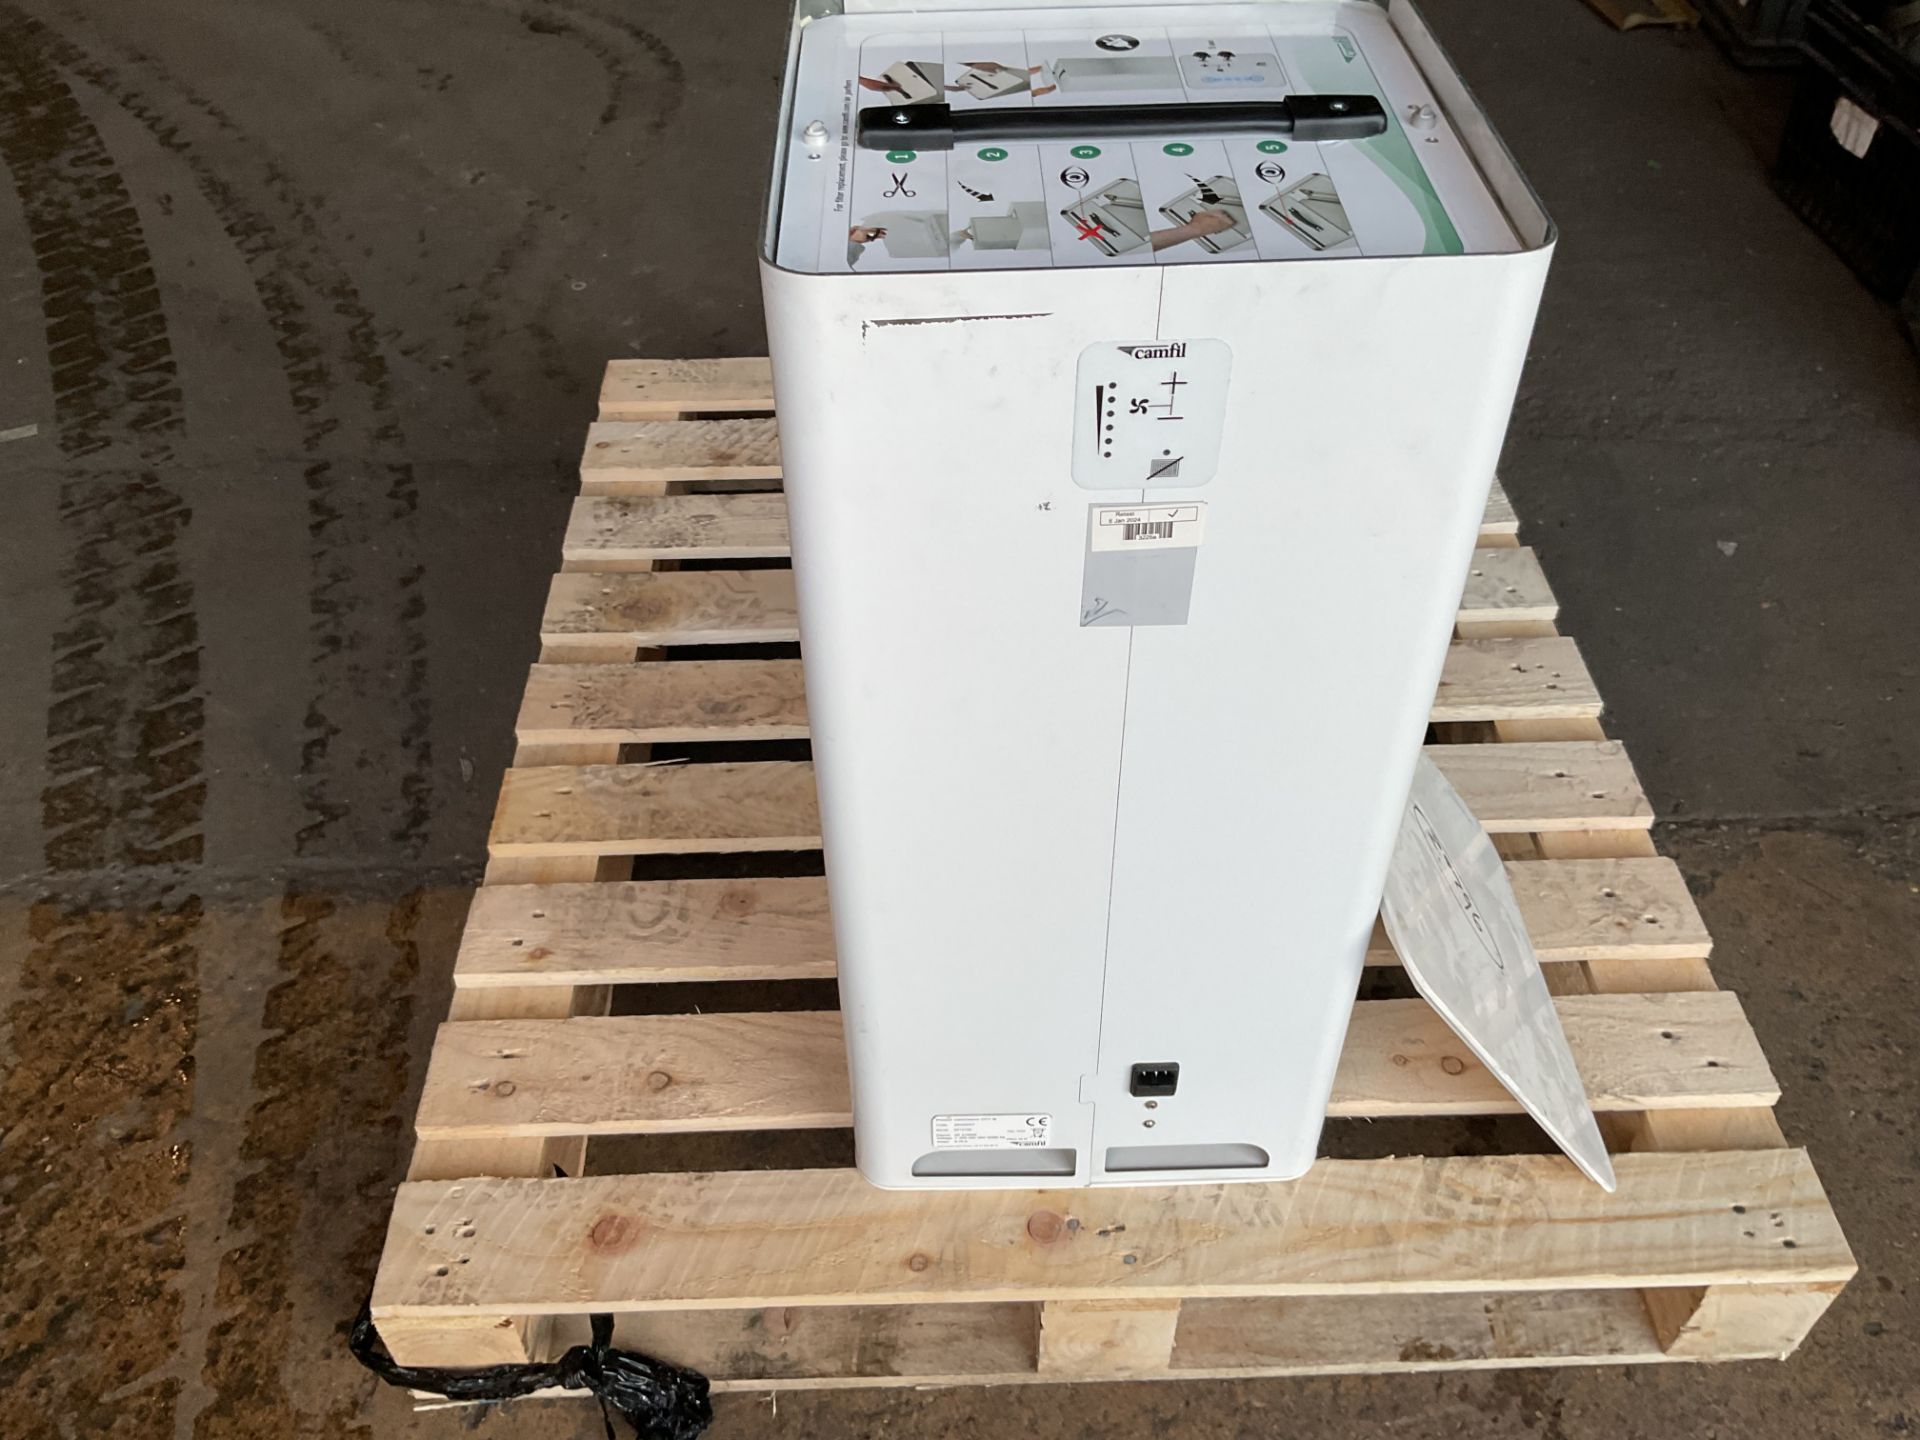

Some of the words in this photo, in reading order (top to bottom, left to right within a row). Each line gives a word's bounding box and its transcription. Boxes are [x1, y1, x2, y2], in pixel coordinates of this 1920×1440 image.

[838, 147, 848, 161] please
[835, 191, 845, 203] filter
[833, 203, 843, 211] For
[1134, 342, 1187, 360] camfil
